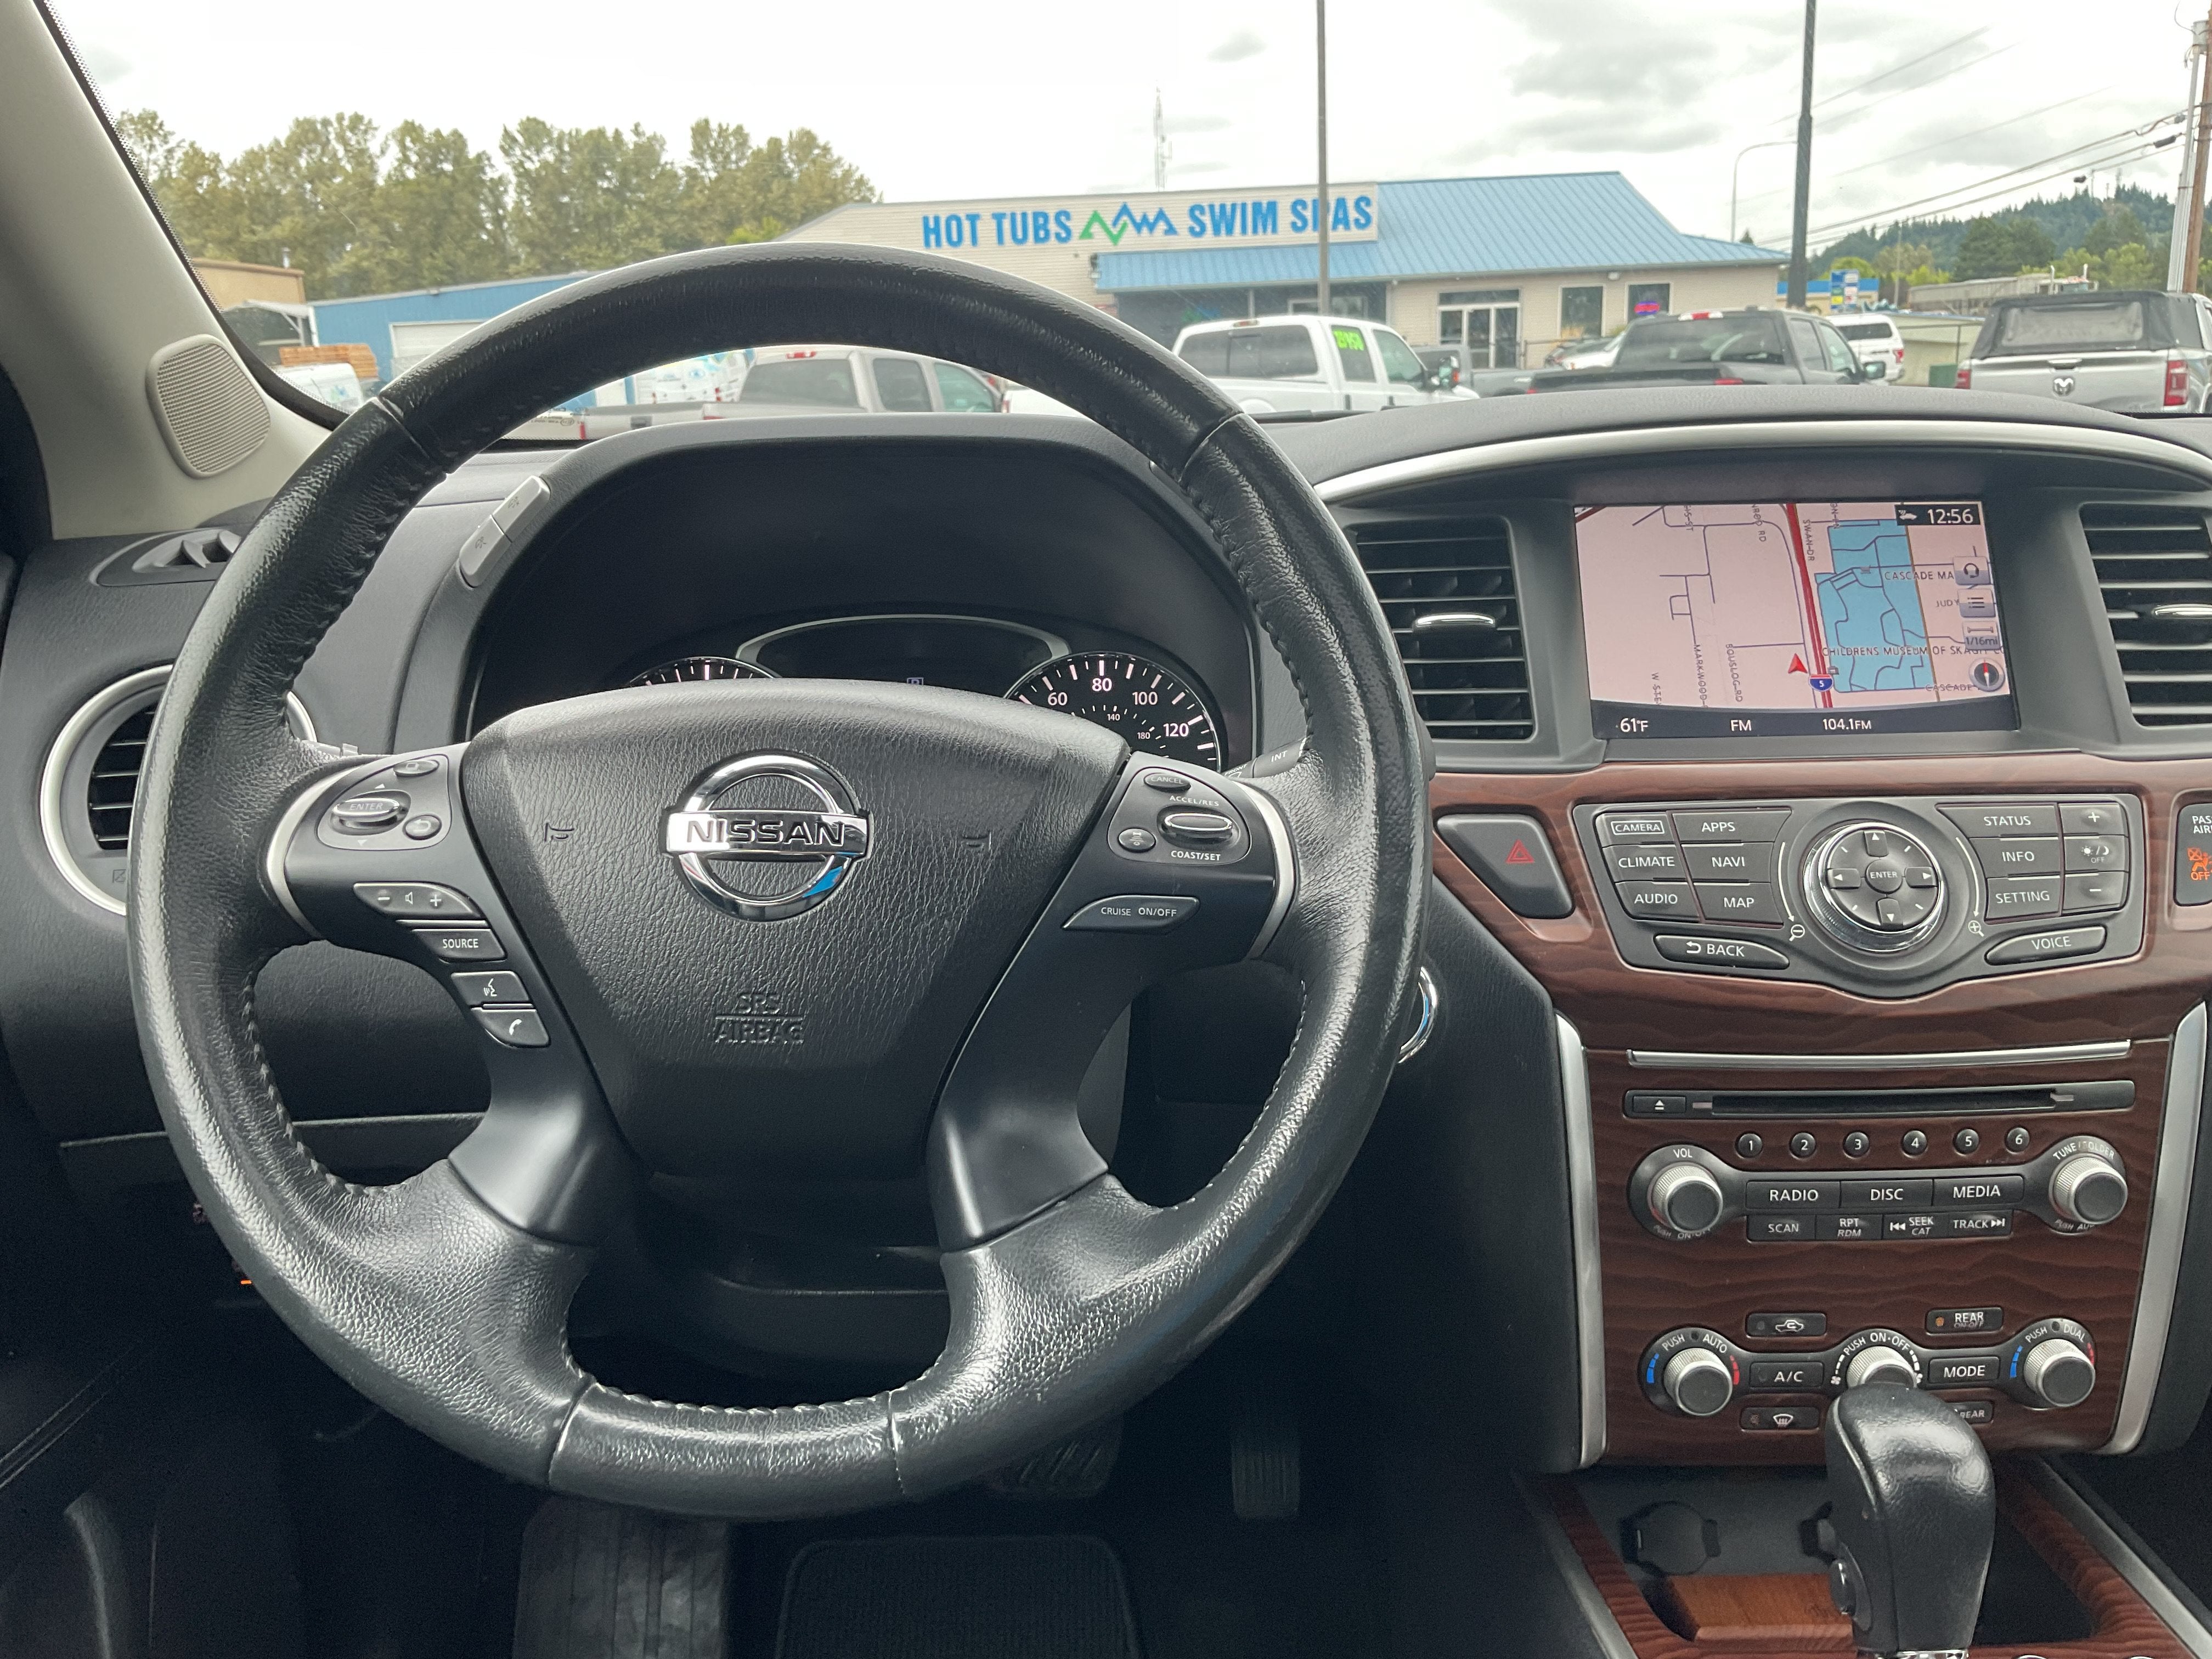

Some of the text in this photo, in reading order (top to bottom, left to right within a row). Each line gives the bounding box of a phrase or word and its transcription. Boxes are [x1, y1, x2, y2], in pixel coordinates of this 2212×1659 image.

[1188, 200, 1278, 238] SWIM
[923, 210, 1073, 249] HOT TUBS
[1928, 509, 1973, 524] 12:56
[1758, 531, 1767, 542] RD
[1803, 520, 1815, 561] SWAN DR
[1884, 571, 1933, 580] CASCADE
[1936, 599, 1959, 607] JUDY
[1966, 636, 1998, 646] 1/16mi
[1822, 647, 1878, 656] CHILDRENS
[1884, 647, 1928, 655] MUSEUM
[1933, 646, 1945, 654] OF
[1694, 645, 1707, 700] MARKWOOD
[1725, 644, 1743, 702] BOUSLOG RD
[1092, 678, 1112, 692] 80
[1047, 692, 1068, 706] 60
[1132, 692, 1158, 705] 100
[1652, 685, 1662, 705] STE
[1163, 723, 1189, 737] 120
[1620, 718, 1648, 732] 61°F
[1731, 720, 1752, 731] FM
[1823, 719, 1872, 730] 104.1FM
[1271, 750, 1288, 763] INT
[1224, 764, 1247, 776] FRONT
[1150, 775, 1183, 785] CANCEL
[1169, 795, 1220, 807] ACCEL/RES
[349, 803, 383, 811] ENTER
[1983, 816, 2031, 826] STATUS
[2192, 815, 2212, 824] PAS
[1615, 824, 1661, 832] CAMERA
[1701, 822, 1735, 832] APPS
[2193, 825, 2212, 834] AIR
[687, 819, 845, 847] NISSAN
[1171, 851, 1221, 861] COAST/SET
[2002, 851, 2035, 862] INFO
[1618, 856, 1675, 868] CLIMATE
[1712, 857, 1745, 867] NAVI
[2191, 872, 2210, 881] OFF
[1634, 894, 1678, 904] AUDIO
[1995, 890, 2050, 904] SETTING
[1724, 898, 1754, 908] MAP
[1101, 907, 1177, 917] CRUISE ON/OFF
[443, 938, 479, 949] SOURCE
[2032, 936, 2072, 950] VOICE
[1707, 944, 1745, 957] BACK
[715, 1020, 803, 1043] AIRBAG
[1749, 1140, 1753, 1150] 1
[1801, 1140, 1808, 1150] 2
[1854, 1139, 1861, 1150] 3
[1911, 1137, 1920, 1148] 4
[1965, 1136, 1972, 1147] 5
[2015, 1135, 2023, 1145] 6
[1673, 1148, 1693, 1158] VOL
[1770, 1189, 1818, 1201] RADIO
[1871, 1188, 1904, 1200] DISC
[1953, 1185, 2001, 1198] MEDIA
[1839, 1218, 1859, 1227] RPT
[1909, 1217, 1934, 1226] SEEK
[1953, 1219, 1989, 1229] TRACK
[1768, 1223, 1799, 1233] SCAN
[1837, 1229, 1861, 1238] RDM
[1911, 1227, 1930, 1235] CAT
[1955, 1312, 1984, 1322] REAR
[2025, 1324, 2086, 1343] PUSH DUAL
[1662, 1334, 1728, 1354] PUSH AUTO
[1844, 1336, 1866, 1356] PUSH
[1944, 1365, 1985, 1378] MODE
[1774, 1372, 1803, 1383] A/C
